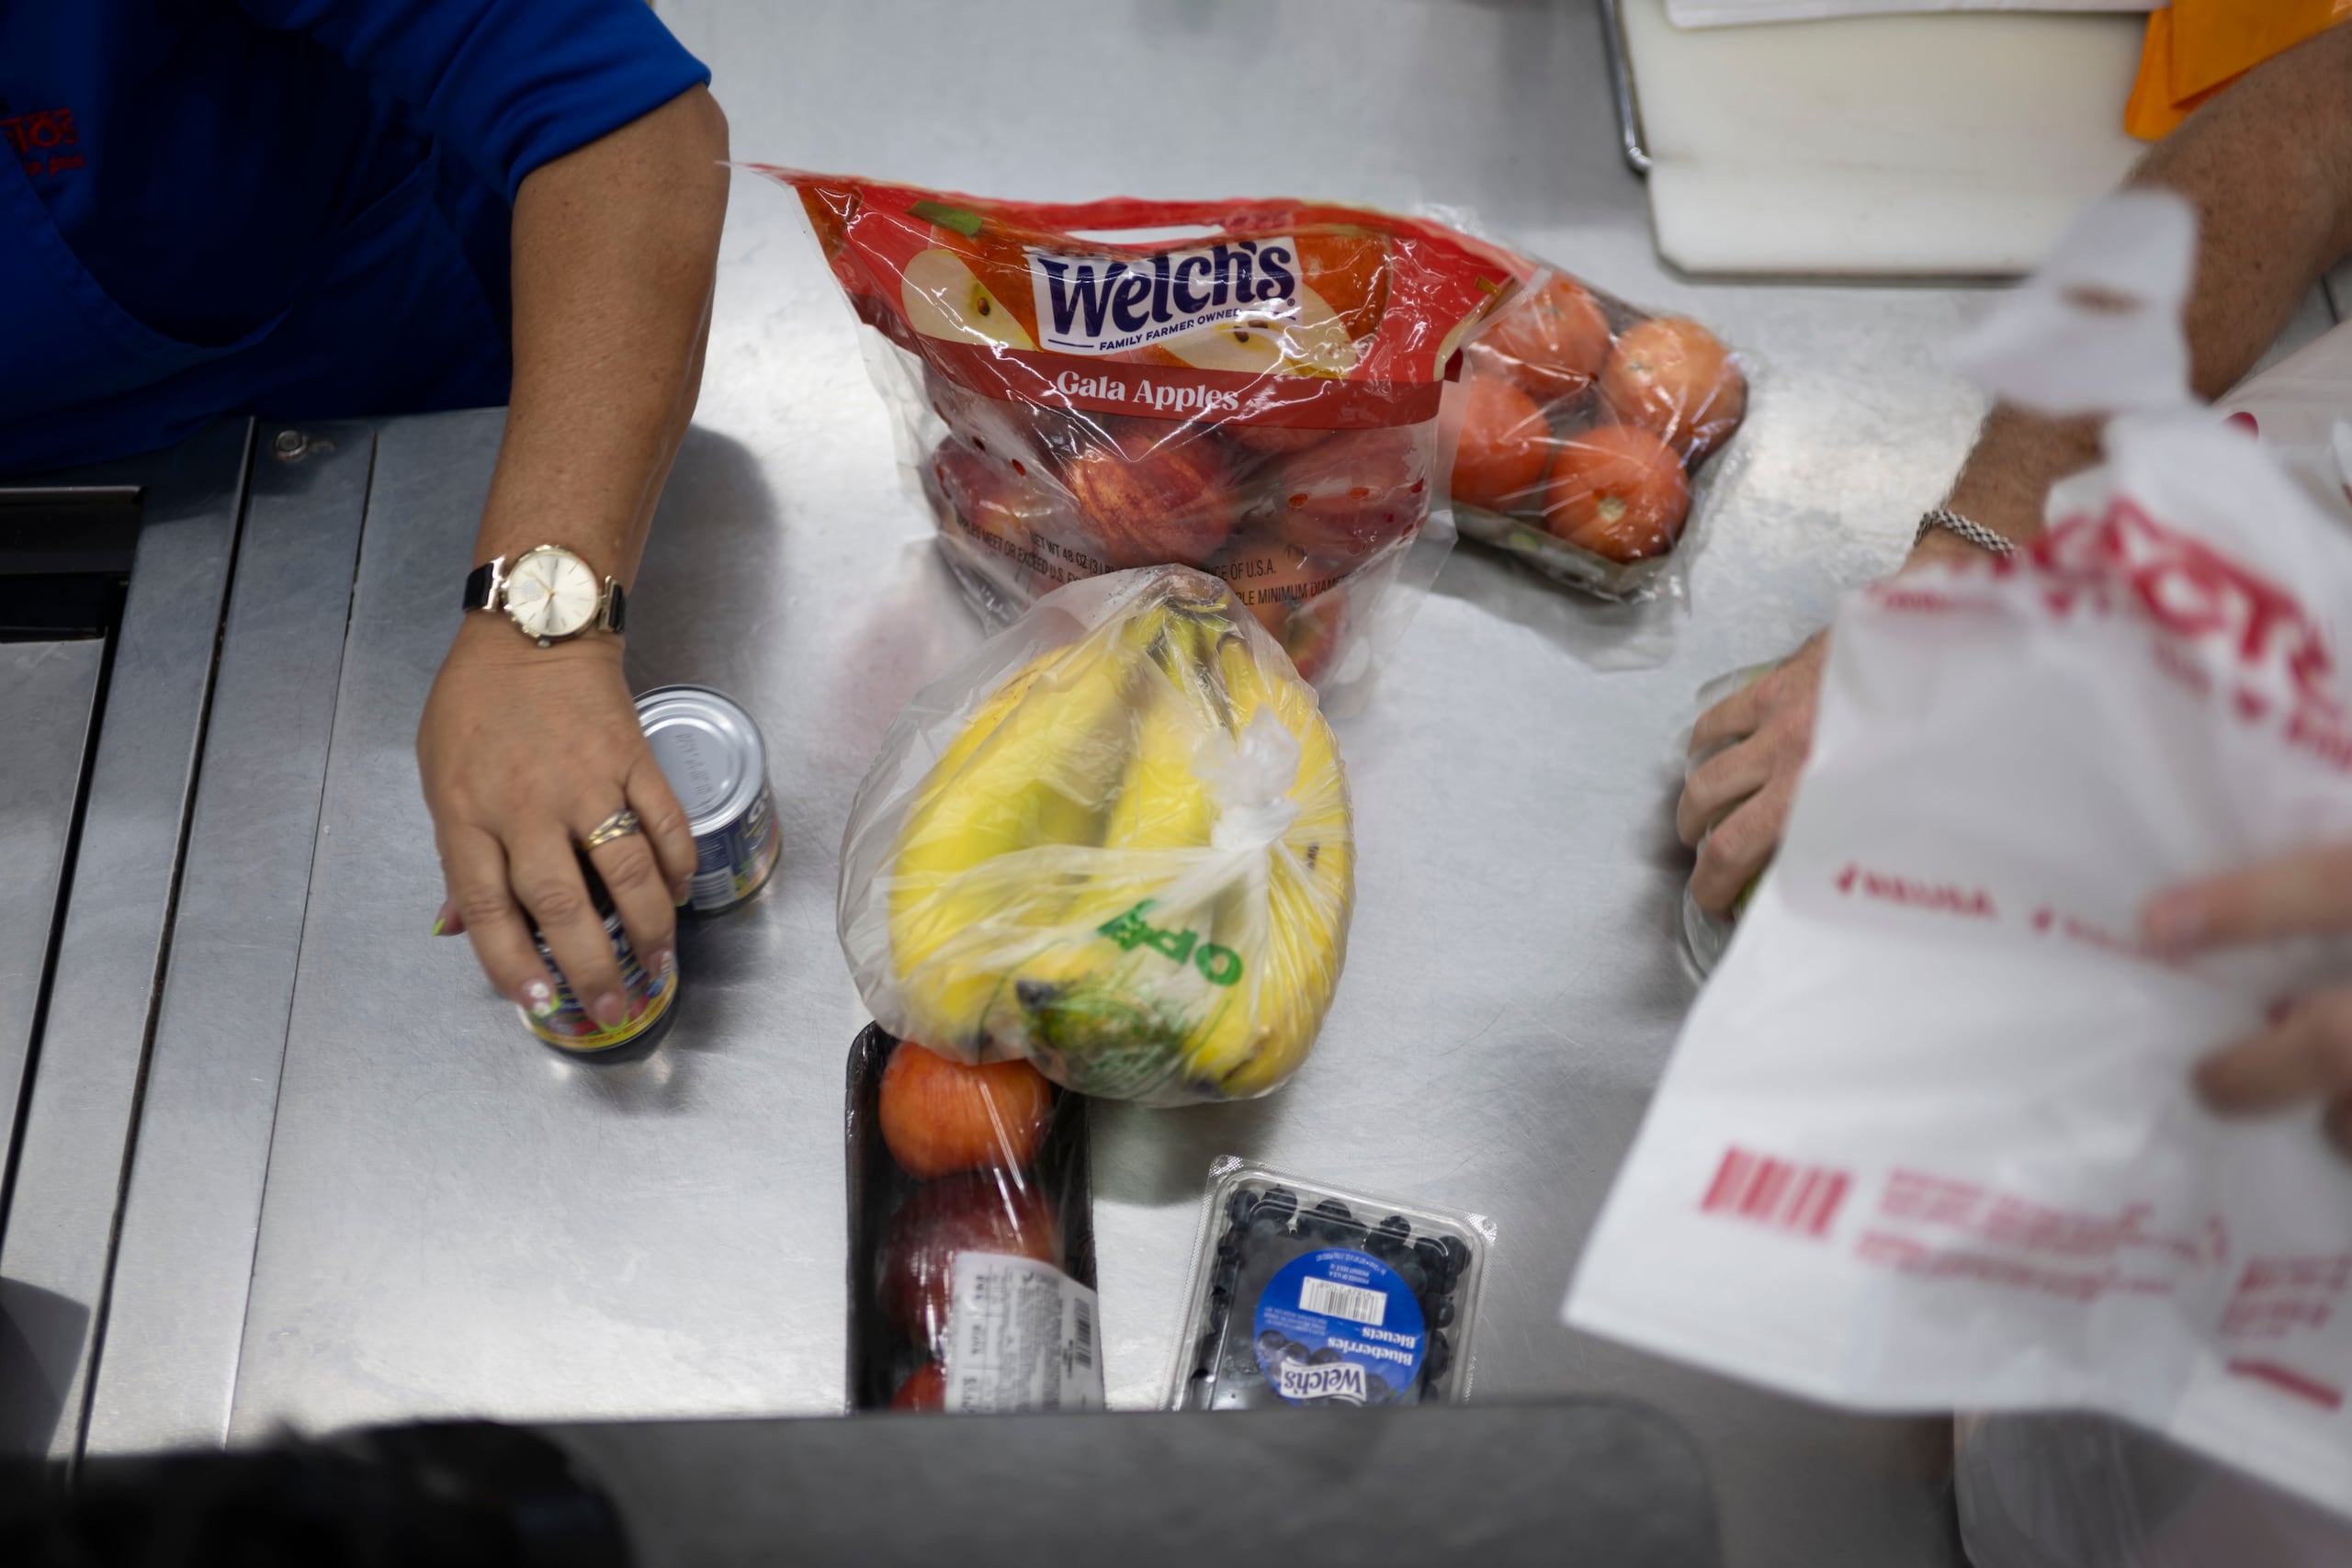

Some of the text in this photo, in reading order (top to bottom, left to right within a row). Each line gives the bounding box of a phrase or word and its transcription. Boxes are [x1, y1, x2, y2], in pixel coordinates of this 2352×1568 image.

[1037, 242, 1295, 338] Welch's
[1099, 308, 1241, 352] FAMILY FARMER OWNED
[1057, 369, 1240, 412] Gala Apples
[981, 529, 1002, 550] MEET
[1005, 540, 1016, 559] OR
[1017, 547, 1048, 574] EXCEED
[1047, 539, 1060, 558] WT
[1062, 547, 1074, 563] 48
[1076, 552, 1088, 570] OZ
[1090, 558, 1099, 574] (3
[1230, 562, 1244, 581] OF
[1246, 558, 1276, 579] U.S.A.
[1258, 582, 1307, 605] MINIMUM
[1328, 1337, 1414, 1367] Blueberries
[1363, 1327, 1417, 1349] Bleuets
[1283, 1369, 1364, 1395] Welch's
